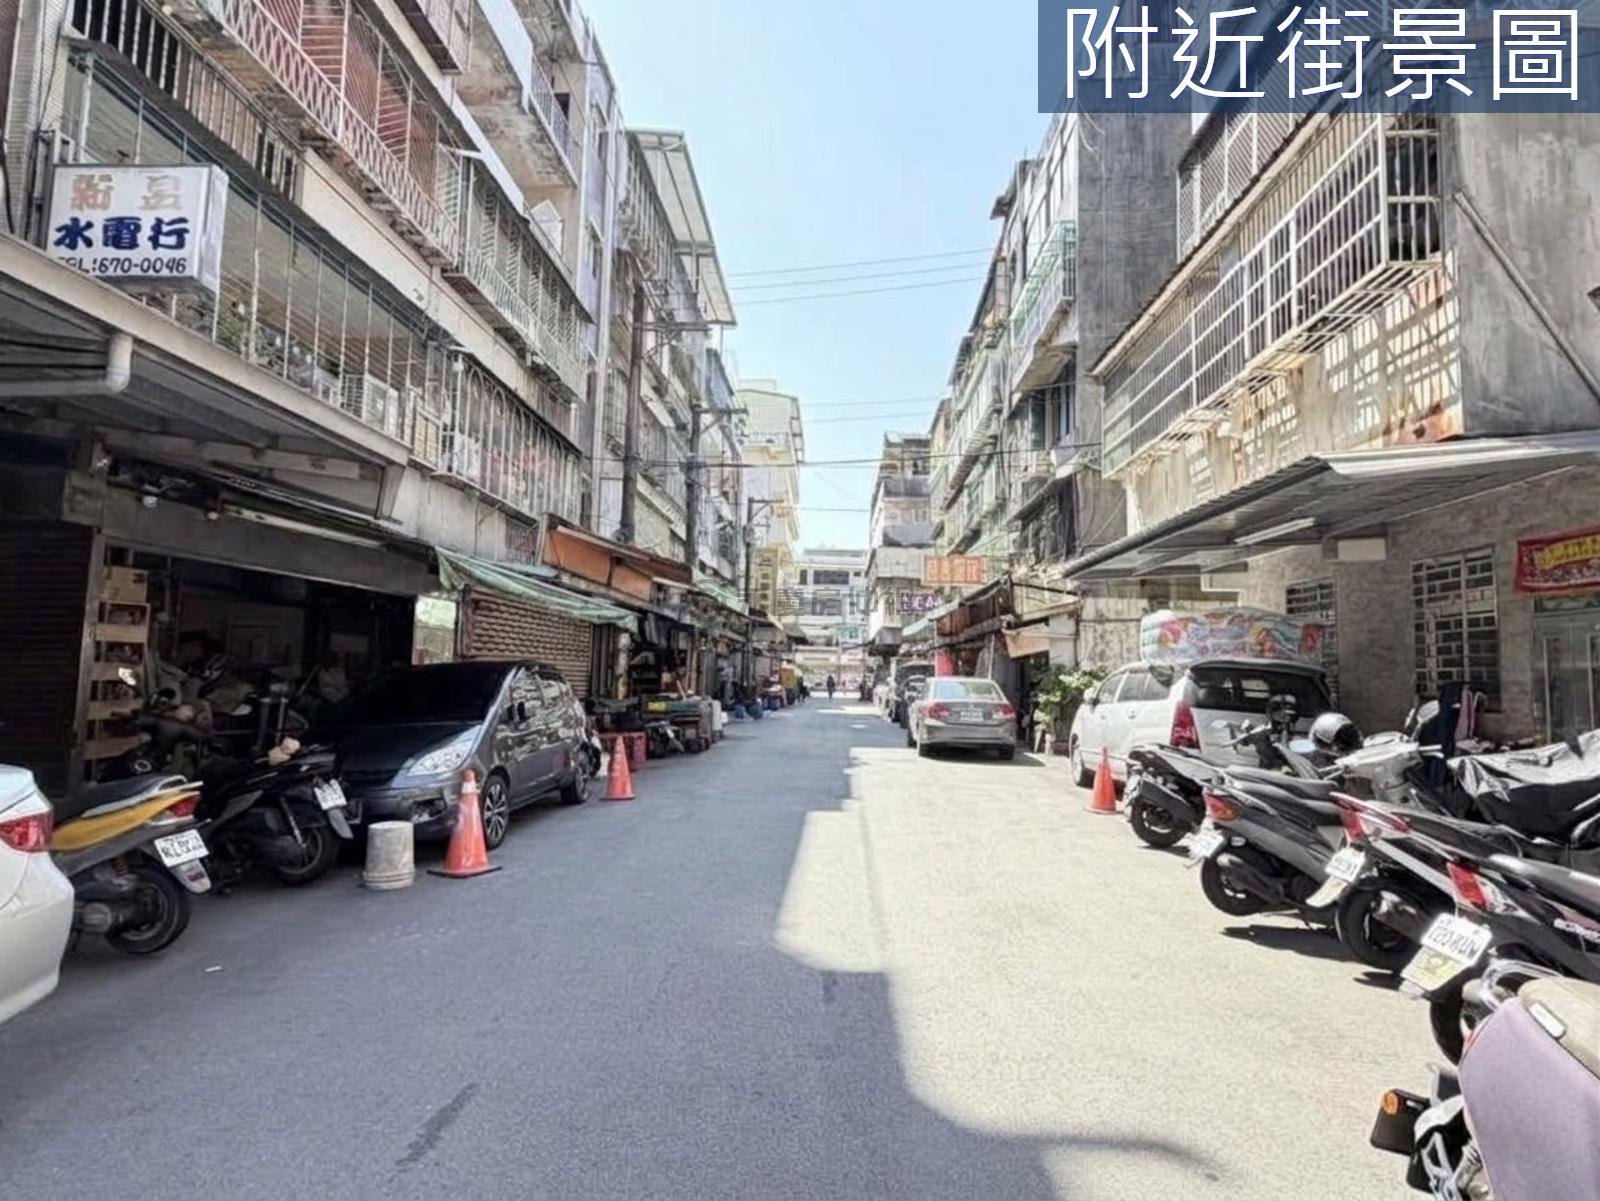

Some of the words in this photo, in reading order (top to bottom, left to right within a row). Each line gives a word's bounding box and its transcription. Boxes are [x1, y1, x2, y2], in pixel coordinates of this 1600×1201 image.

[53, 216, 190, 250] 水電行
[58, 256, 188, 274] EL:670-0046
